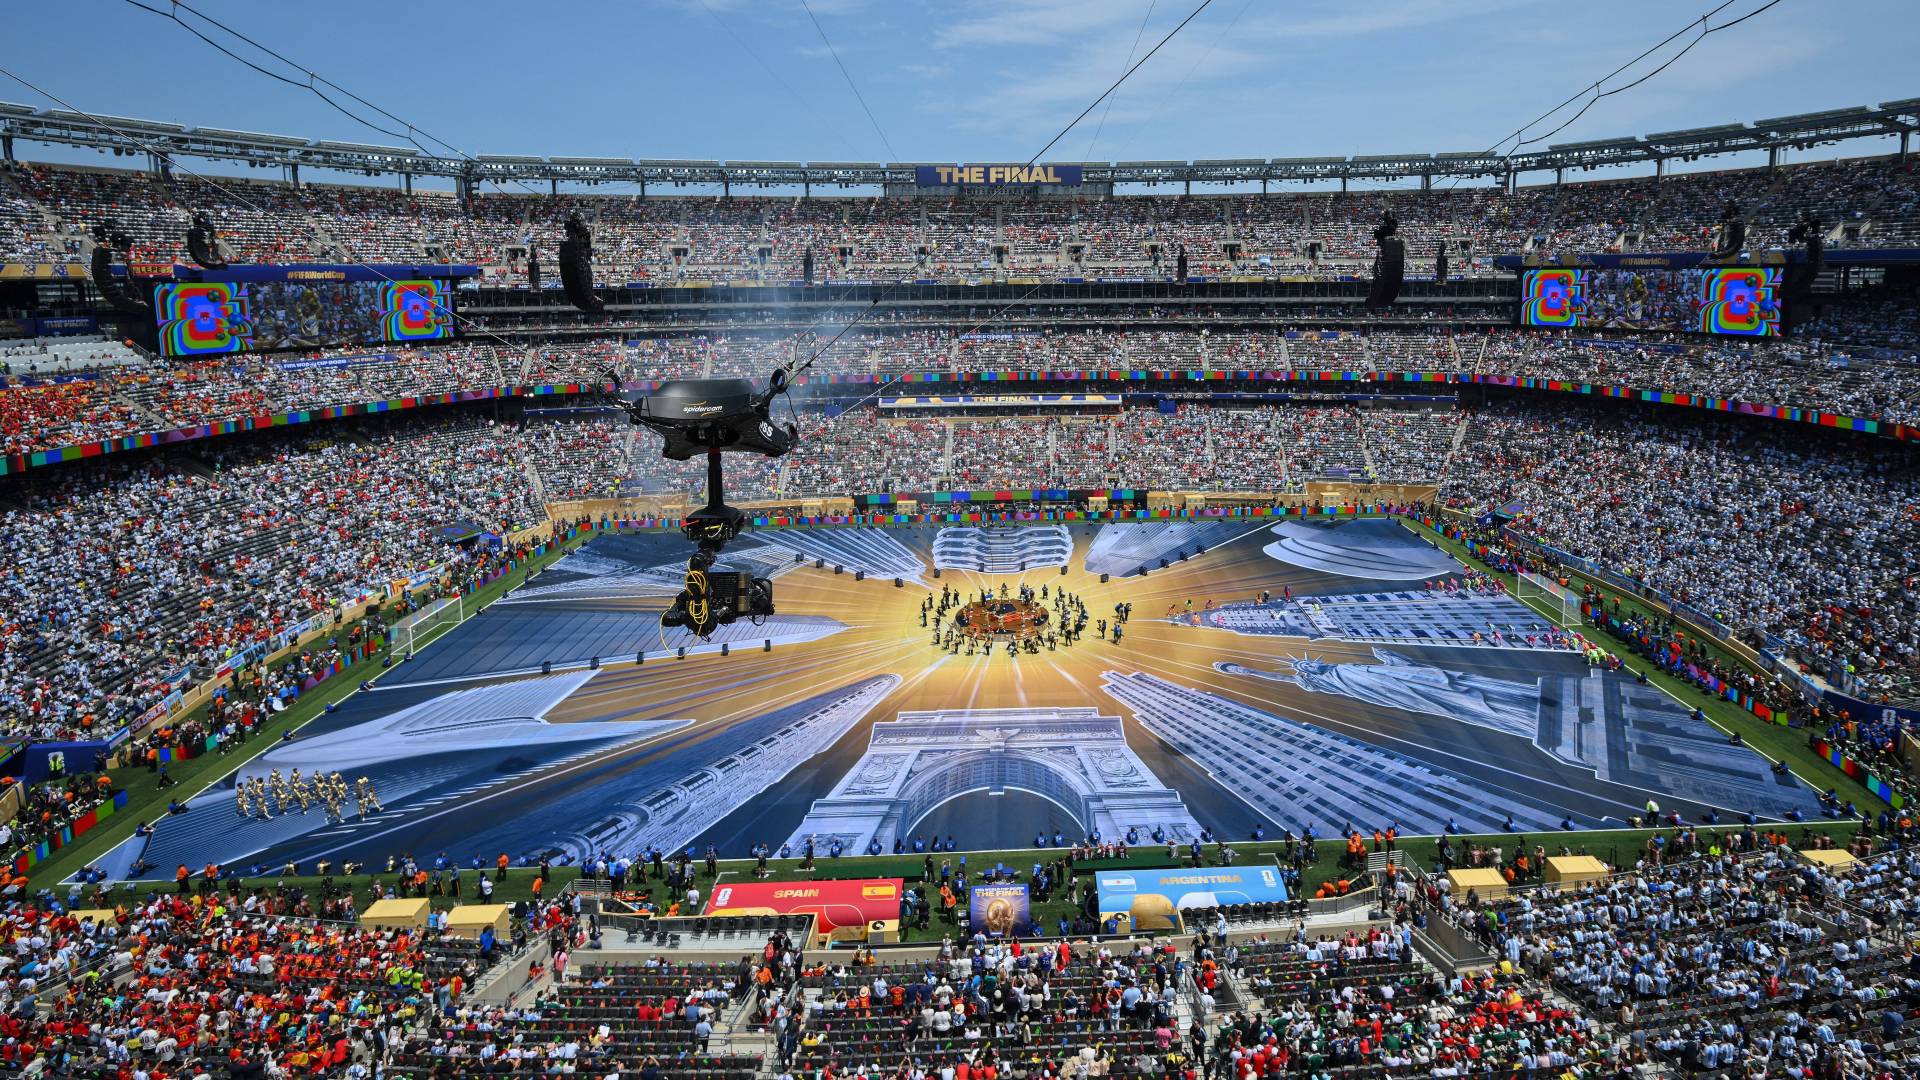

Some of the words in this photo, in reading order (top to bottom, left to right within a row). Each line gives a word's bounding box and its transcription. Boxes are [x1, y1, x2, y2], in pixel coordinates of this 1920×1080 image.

[936, 167, 984, 183] THE
[990, 167, 1061, 183] FINAL
[288, 271, 345, 280] #FIFAWorldCup
[683, 405, 722, 414] spidercam
[1160, 875, 1242, 885] ARGENTINA
[773, 889, 819, 898] SPAIN
[996, 889, 1024, 897] FINAL
